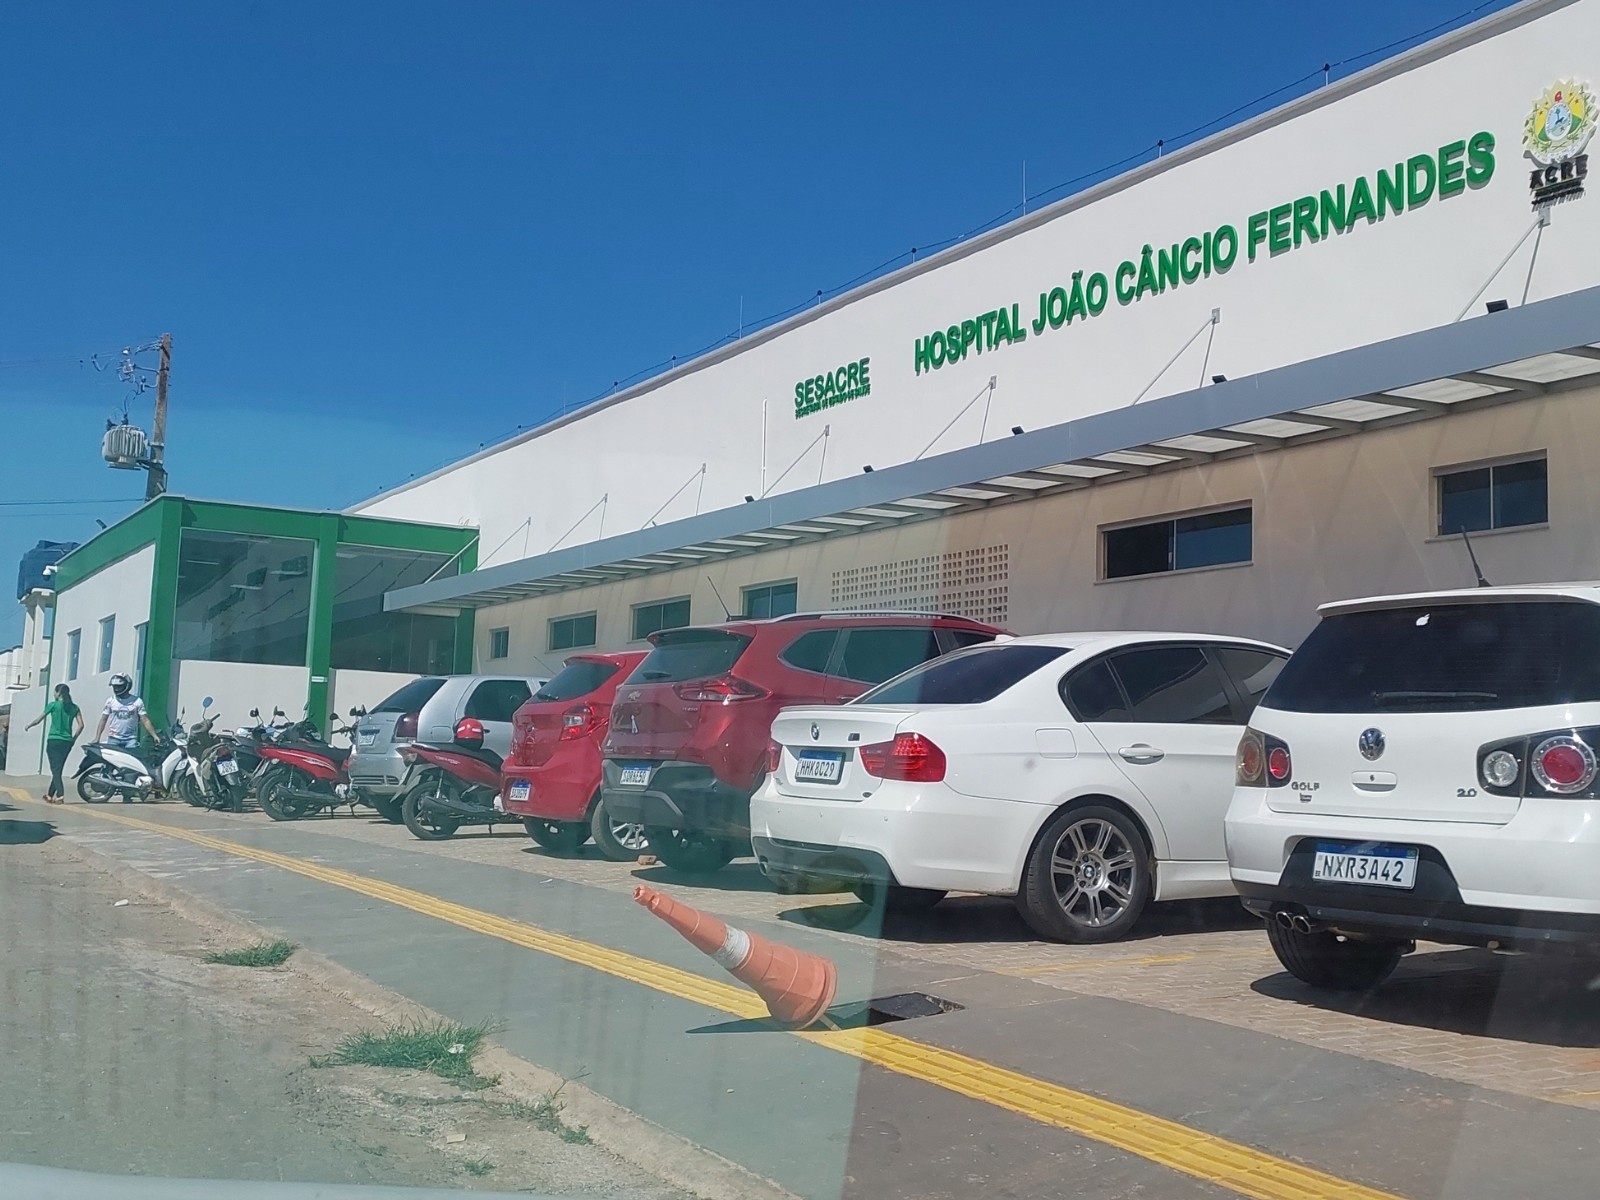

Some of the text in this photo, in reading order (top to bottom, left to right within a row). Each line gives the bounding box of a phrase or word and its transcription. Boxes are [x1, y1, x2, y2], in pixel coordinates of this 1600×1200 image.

[1529, 154, 1589, 193] ACRE
[914, 131, 1496, 375] HOSPITAL JOÃO CÂNCIO FERNANDES
[794, 357, 871, 408] SESACRE
[1291, 781, 1320, 791] GOLF
[1322, 855, 1405, 882] NXR3A42
